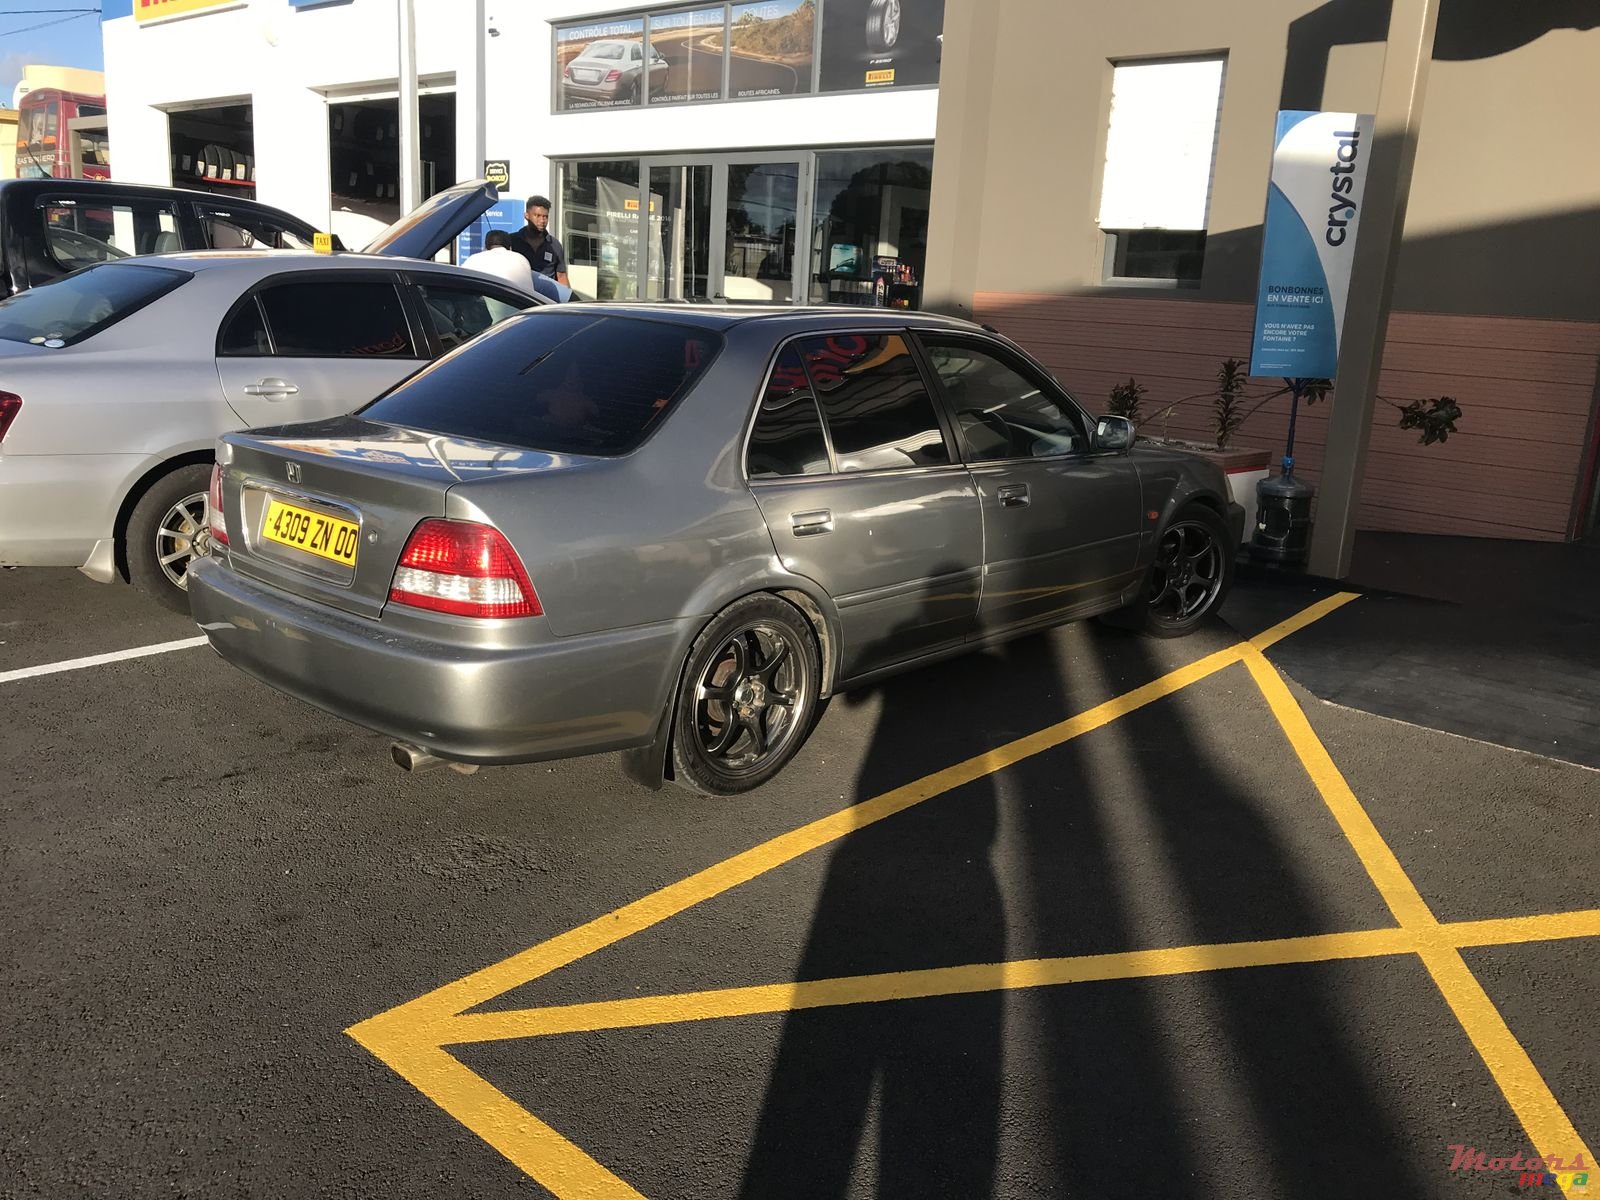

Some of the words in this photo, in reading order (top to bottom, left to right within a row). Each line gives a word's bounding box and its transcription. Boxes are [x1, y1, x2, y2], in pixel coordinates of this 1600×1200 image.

[569, 26, 608, 41] CONTRÔLE
[1326, 131, 1360, 247] crystal
[606, 211, 631, 219] PIRELLI
[315, 236, 329, 246] TAXI
[1268, 285, 1324, 295] BONBONNES
[1267, 294, 1279, 302] EN
[1281, 295, 1310, 304] VENTE
[1312, 296, 1324, 304] ICI
[273, 509, 311, 545] 4309
[310, 518, 335, 553] ZN
